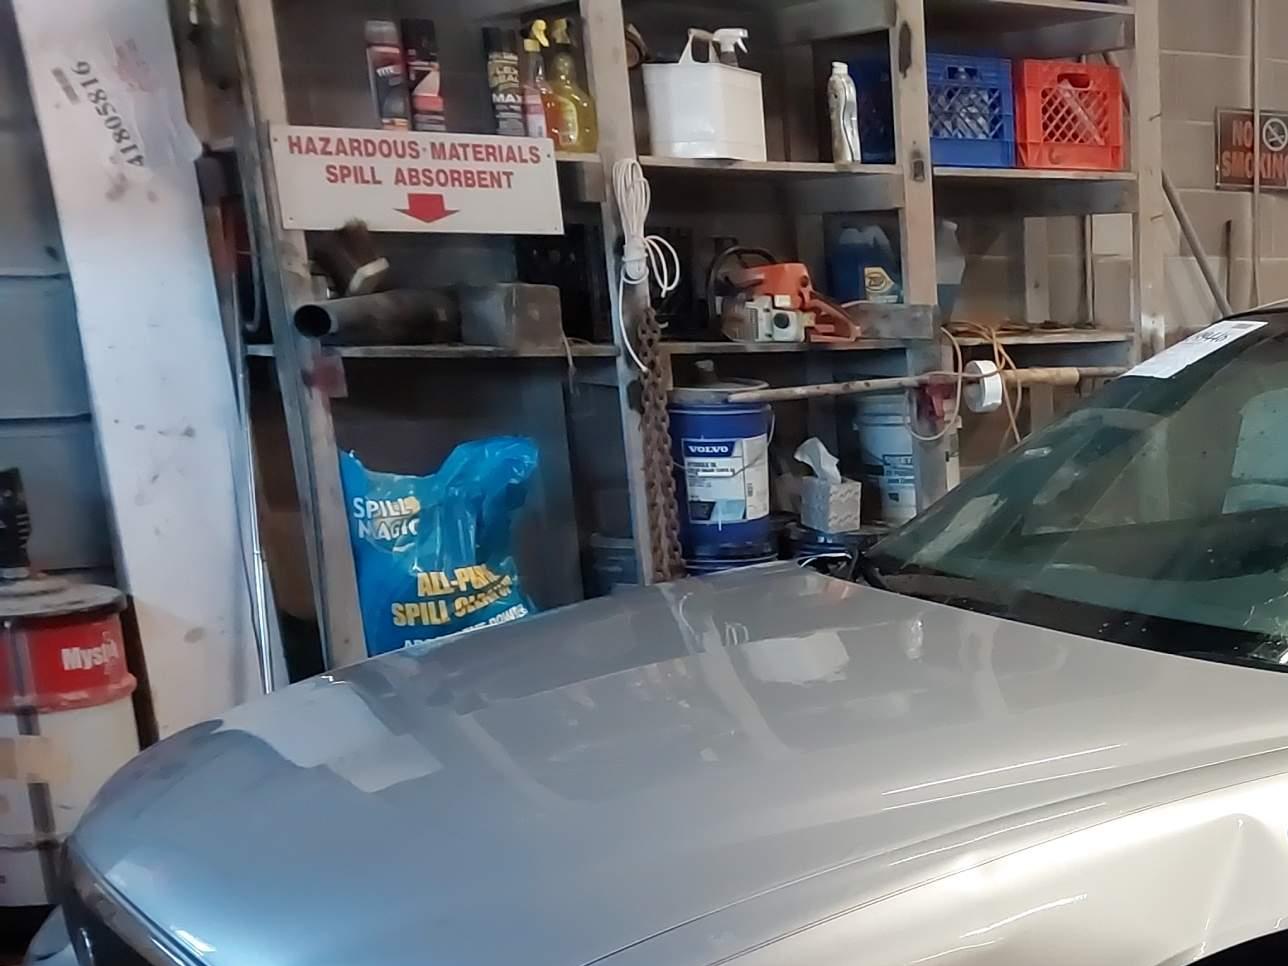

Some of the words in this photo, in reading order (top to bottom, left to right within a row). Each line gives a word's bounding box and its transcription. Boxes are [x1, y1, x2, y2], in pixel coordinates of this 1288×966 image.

[71, 61, 145, 167] 41805816
[1232, 121, 1253, 147] NO
[287, 135, 421, 160] HAZARDOUS
[430, 141, 542, 165] MATERIALS
[325, 164, 382, 185] SPILL
[394, 167, 514, 189] ABSORBENT
[688, 445, 729, 453] VOLVO
[352, 498, 411, 519] SPILL
[391, 599, 450, 627] SPILL
